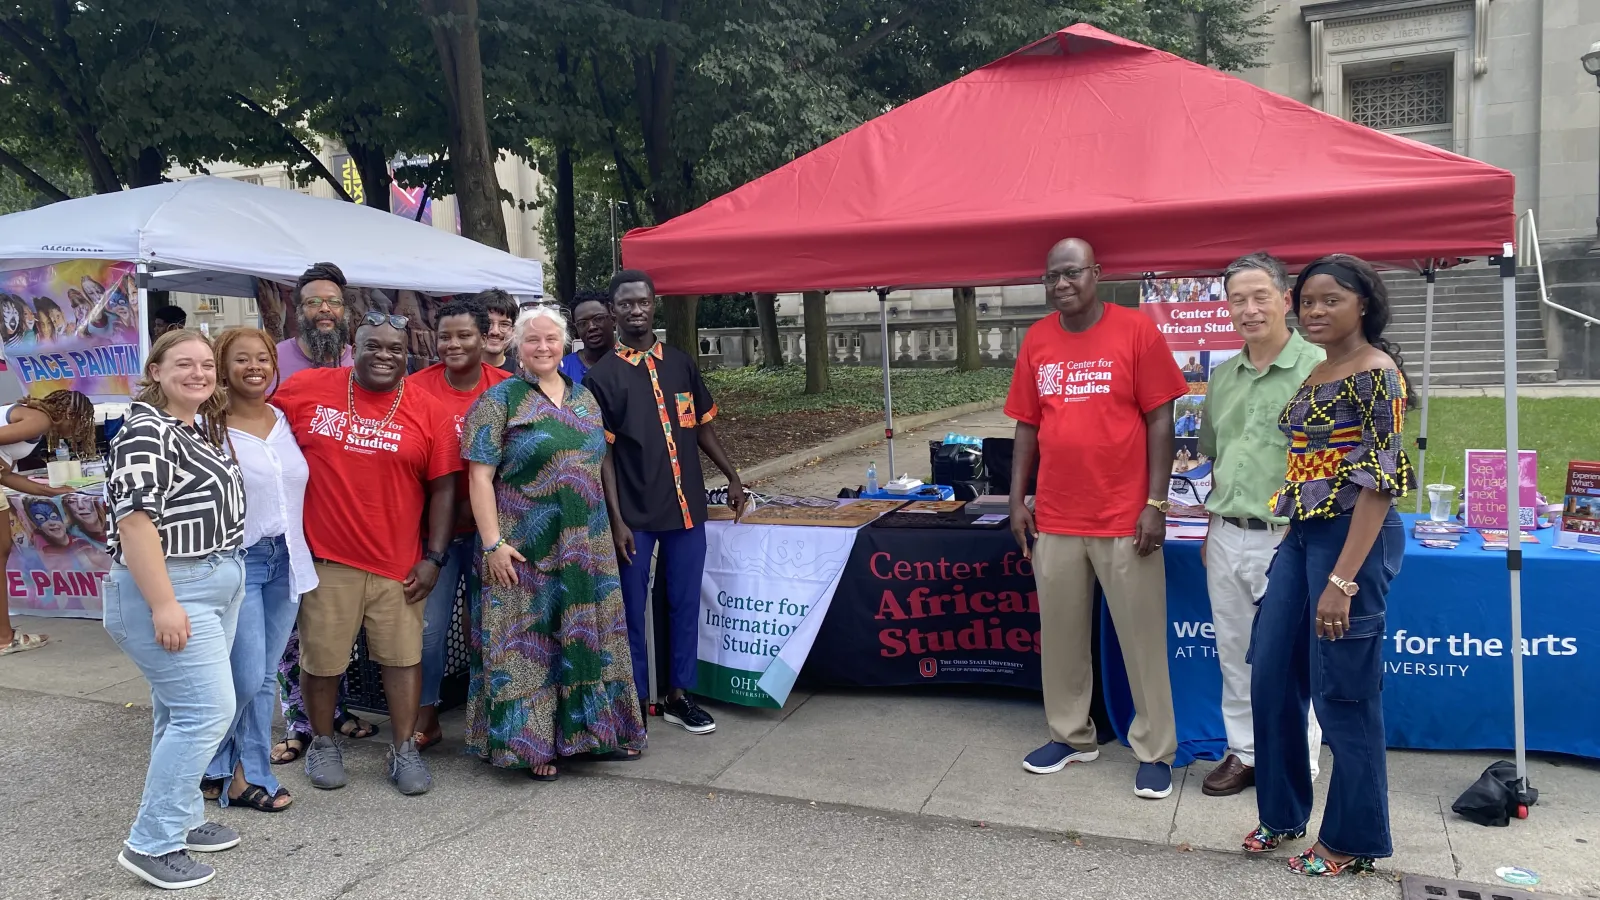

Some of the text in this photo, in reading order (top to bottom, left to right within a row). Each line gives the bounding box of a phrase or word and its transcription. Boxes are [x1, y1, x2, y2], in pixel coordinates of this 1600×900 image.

[1372, 33, 1386, 41] OF
[1393, 27, 1432, 39] LIBERTY
[1170, 307, 1231, 319] Center fo
[1204, 322, 1237, 333] Stud
[16, 344, 140, 383] FACE PAINTIN
[1066, 358, 1113, 370] Center for
[1065, 369, 1112, 383] African
[1064, 381, 1111, 395] Studies
[352, 415, 403, 431] Center for
[349, 423, 402, 441] African
[345, 433, 399, 452] Studies
[1471, 463, 1493, 474] See
[1571, 479, 1594, 488] What's
[1471, 489, 1499, 500] next
[1470, 501, 1506, 513] at the
[1470, 514, 1499, 525] Wex
[869, 551, 1033, 581] Center fo
[717, 590, 810, 617] Center for
[722, 634, 781, 658] Studie
[1393, 629, 1441, 655] for
[1446, 632, 1503, 657] the
[1510, 634, 1578, 656] arts
[988, 659, 1024, 668] UNIVERSITY
[1174, 645, 1469, 677] AT TH IVERSITY
[730, 675, 758, 691] OHI
